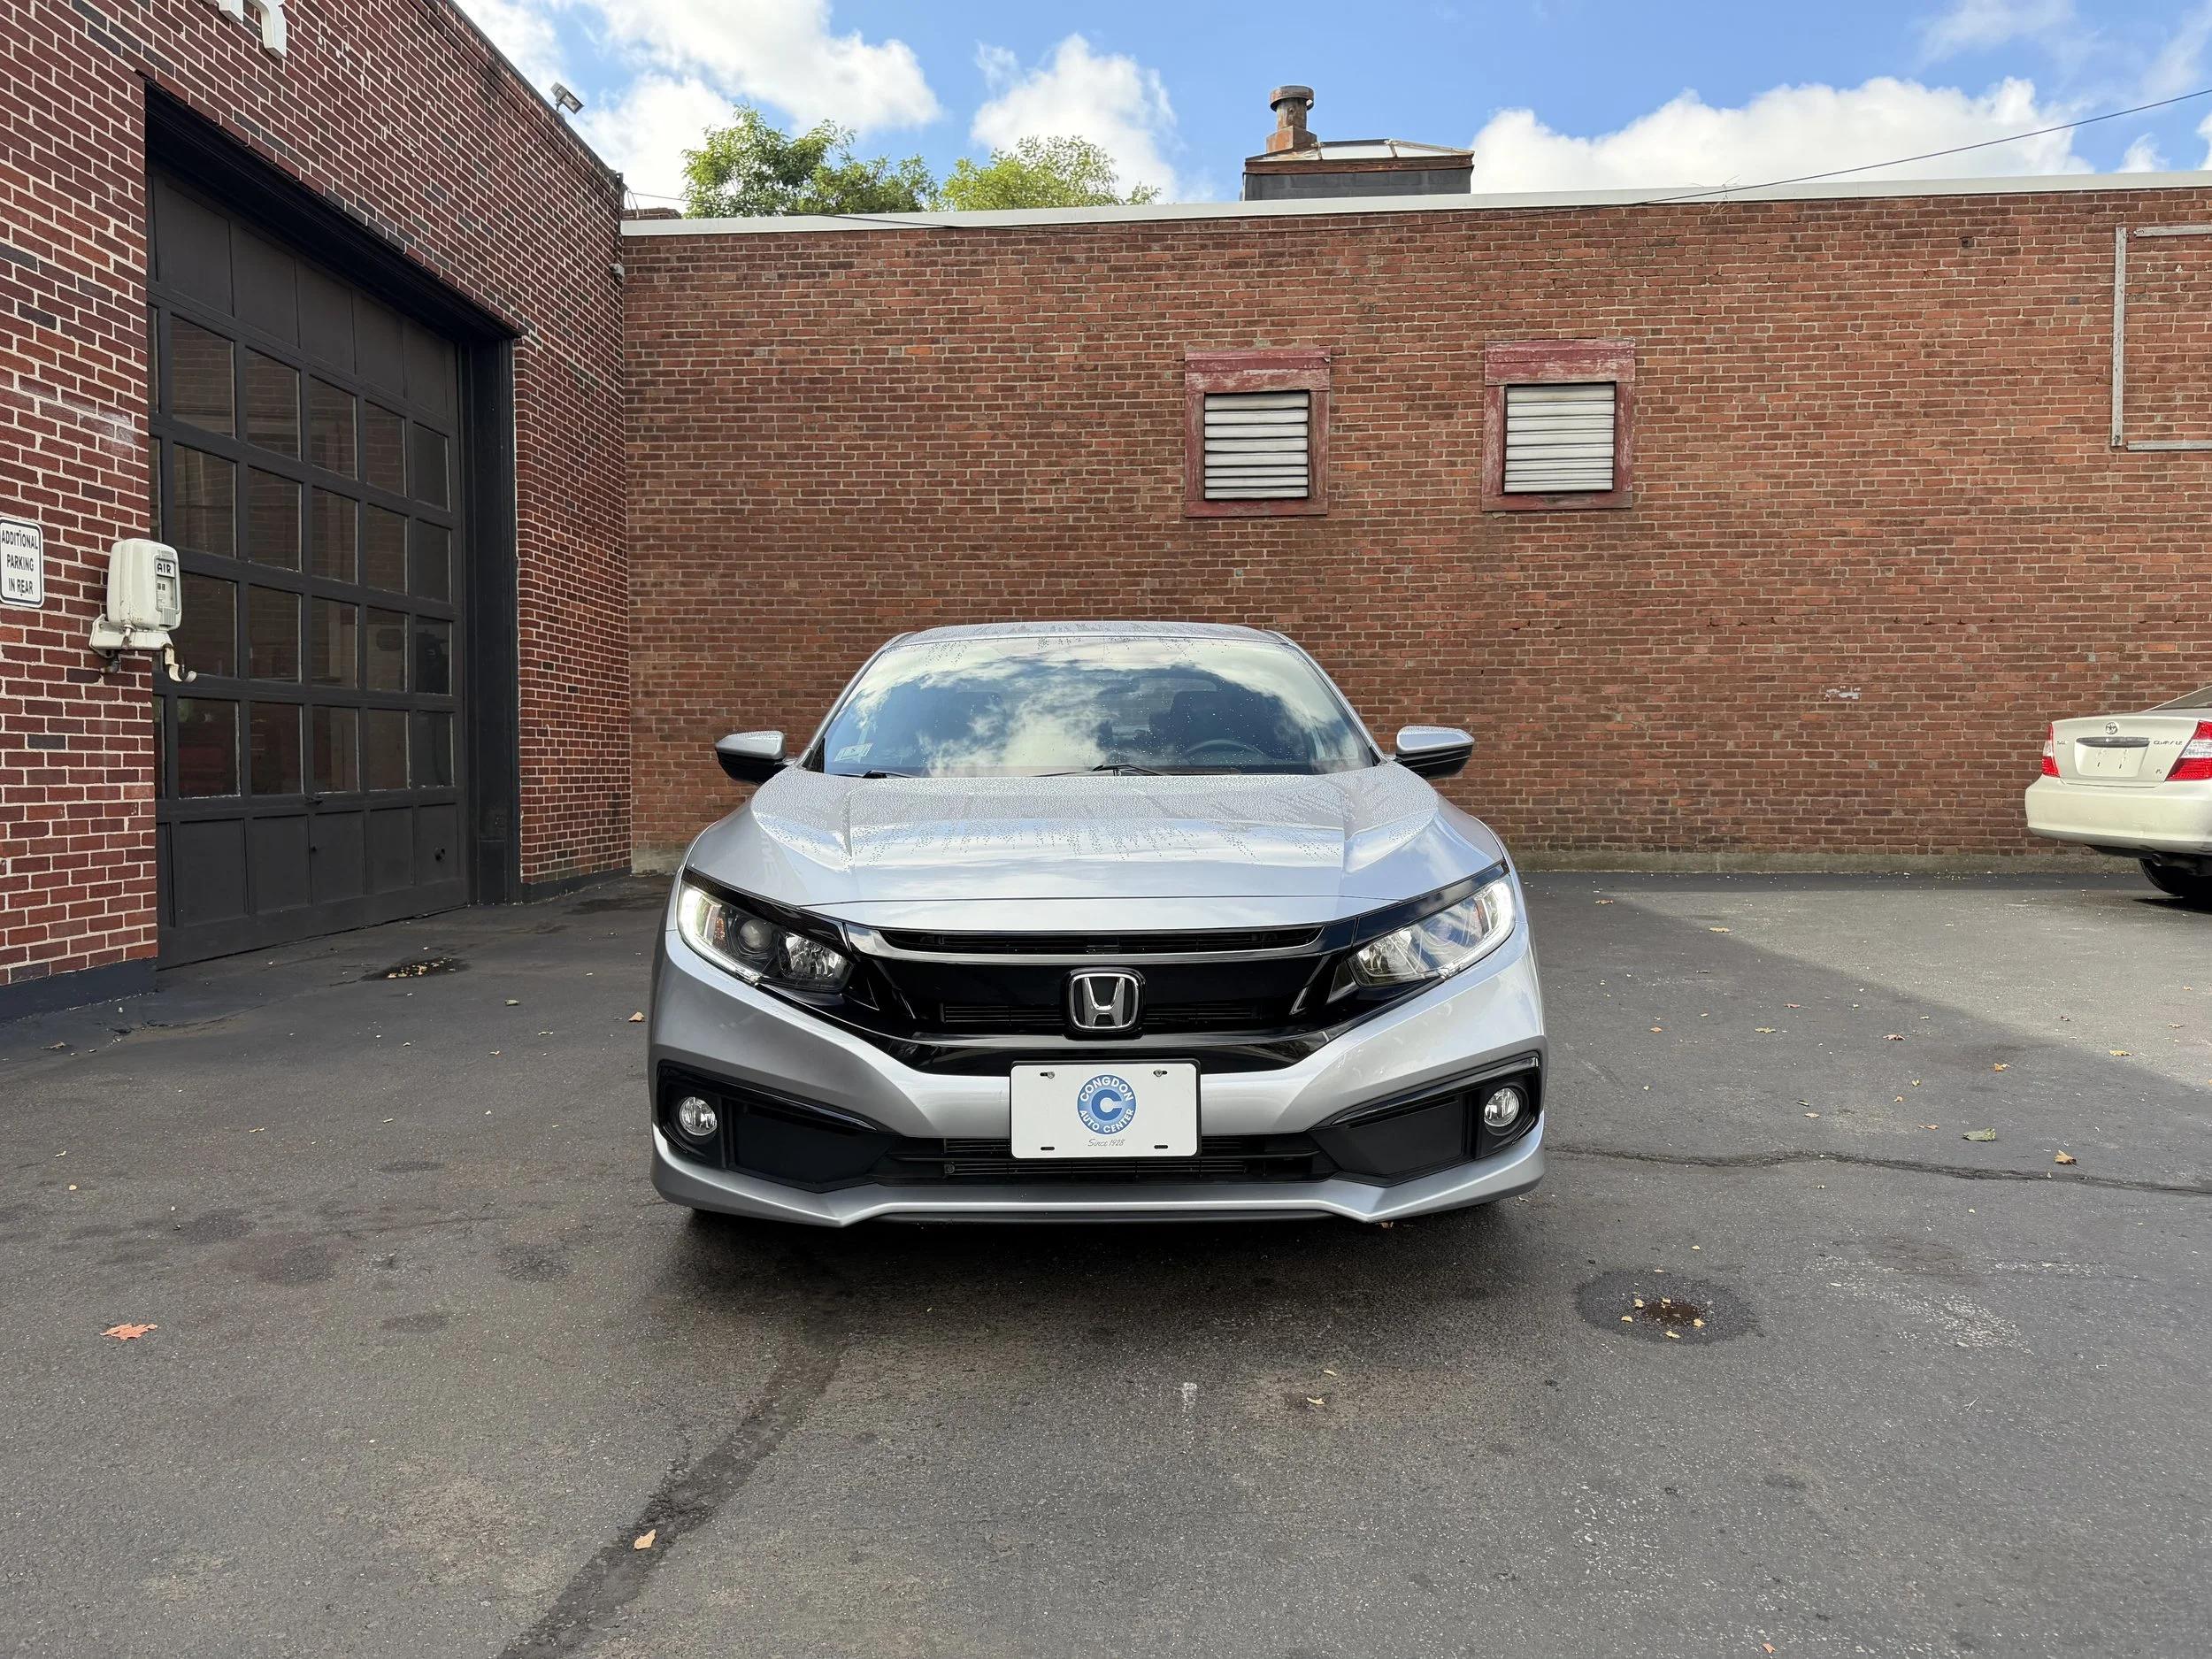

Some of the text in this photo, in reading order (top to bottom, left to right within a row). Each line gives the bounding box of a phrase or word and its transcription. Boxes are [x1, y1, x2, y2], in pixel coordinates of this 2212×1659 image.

[2, 530, 38, 549] ADDITIONAL
[7, 554, 34, 572] PARKING
[157, 563, 171, 574] AIR
[9, 578, 33, 595] IN REAR
[1079, 1076, 1133, 1102] CONGDON
[1091, 1089, 1122, 1121] C
[1079, 1109, 1134, 1133] AUTO CENTER
[1087, 1138, 1108, 1147] Since
